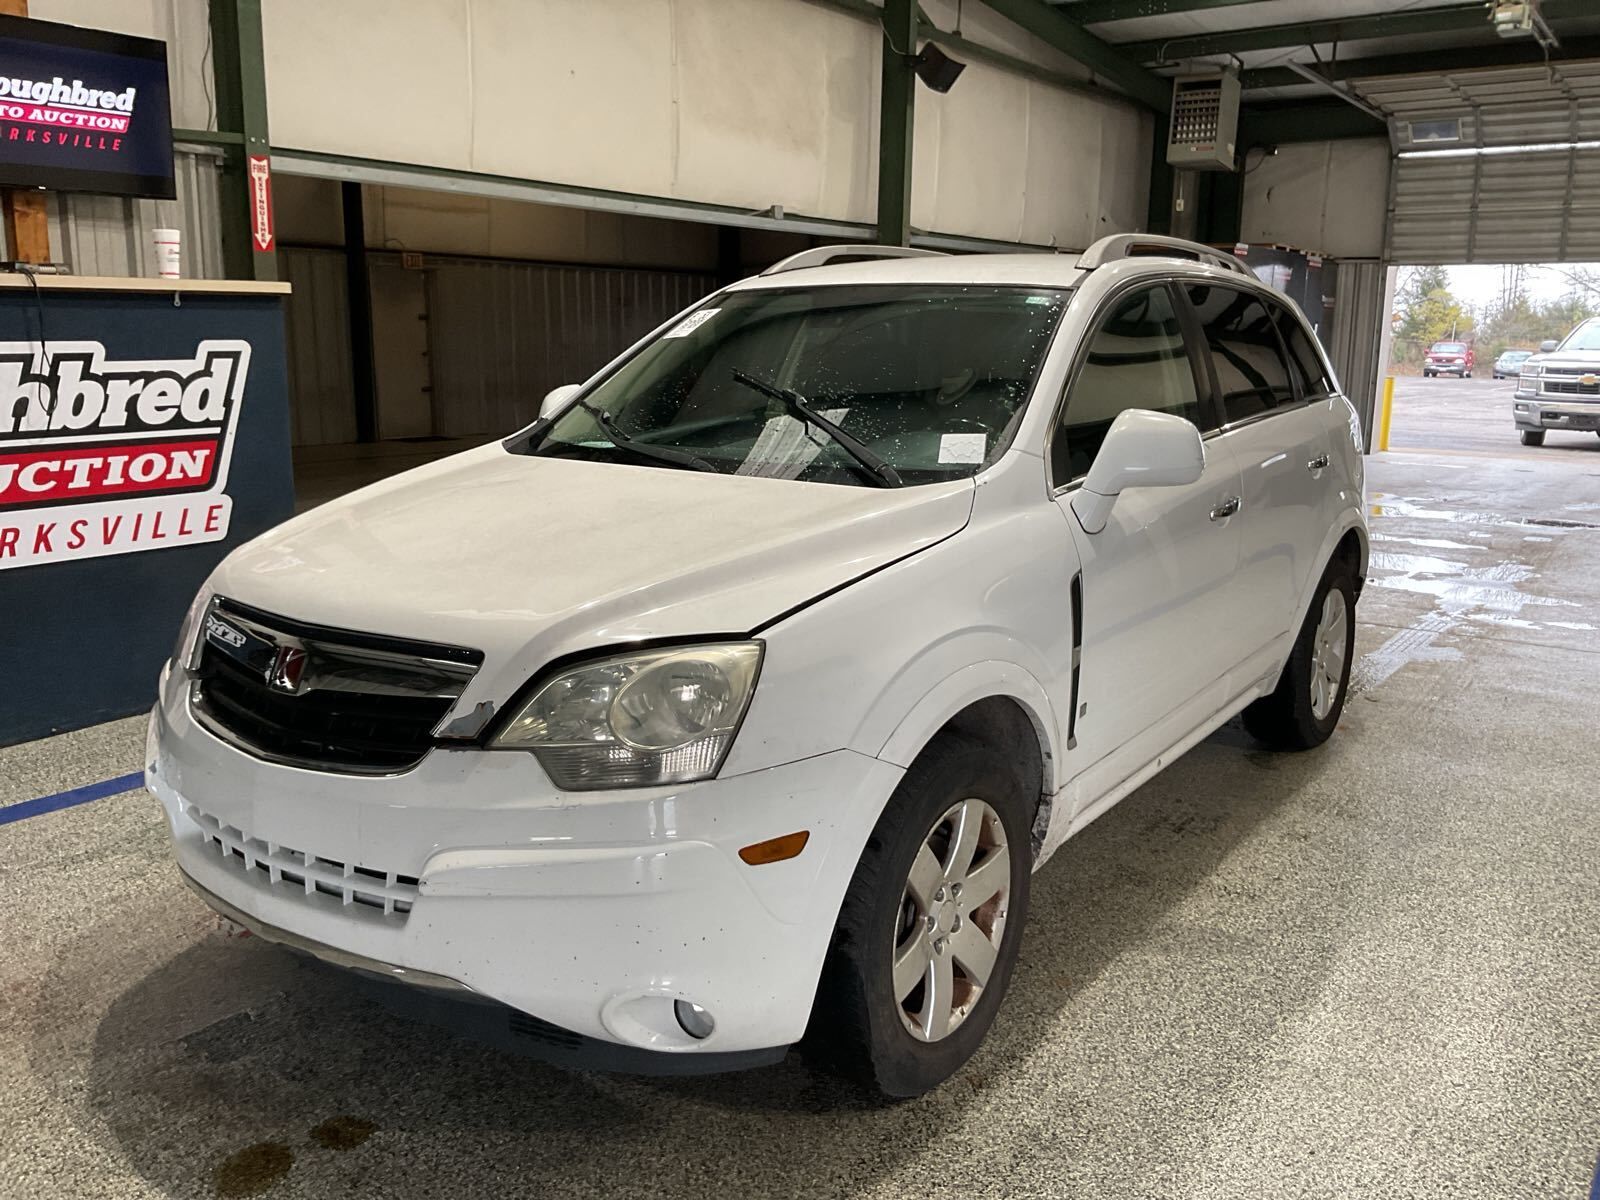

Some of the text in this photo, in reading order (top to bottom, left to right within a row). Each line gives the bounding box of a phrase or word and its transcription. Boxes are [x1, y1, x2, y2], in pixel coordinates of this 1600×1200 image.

[0, 77, 136, 111] oughbred
[28, 108, 127, 130] AUCTION
[0, 126, 122, 151] RKSVILLE
[252, 164, 267, 174] FIRE
[257, 176, 267, 244] EXTINGUISHER
[0, 358, 234, 432] hbred
[0, 505, 223, 558] RKSVILLE
